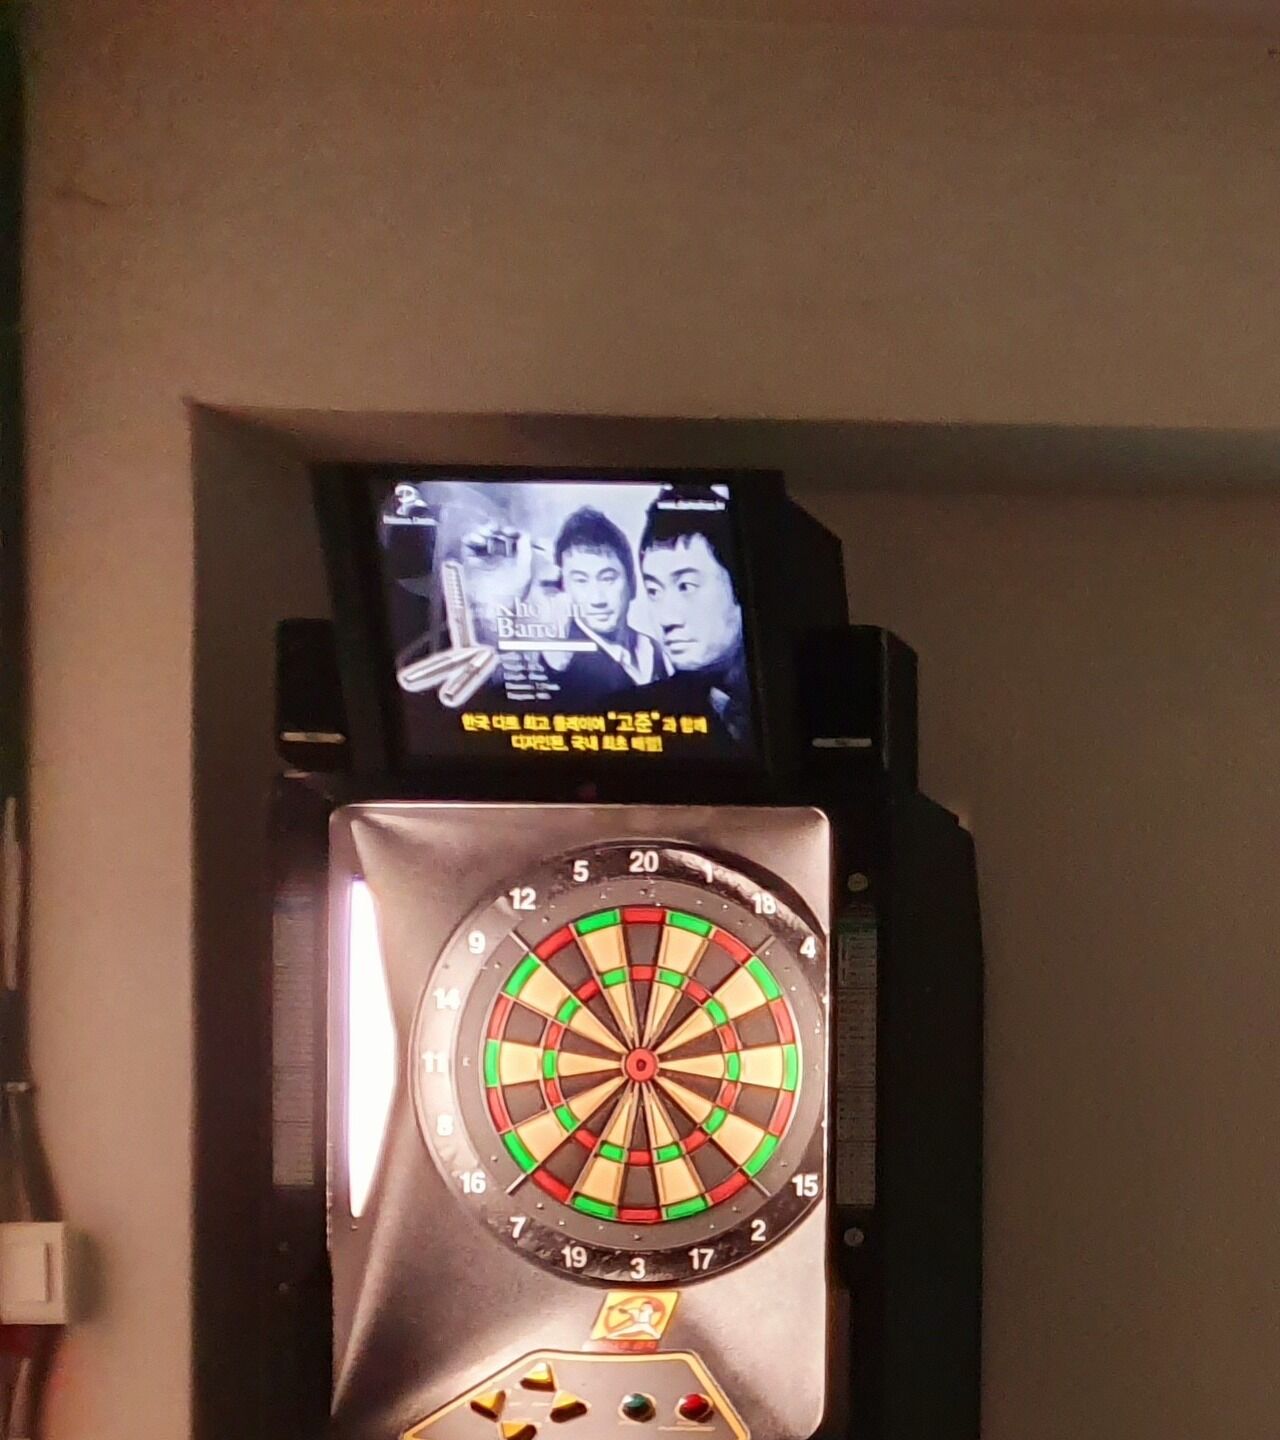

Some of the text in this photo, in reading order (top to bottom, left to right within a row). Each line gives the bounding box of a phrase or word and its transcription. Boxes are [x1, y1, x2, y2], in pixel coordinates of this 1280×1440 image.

[498, 617, 567, 639] Barrel
[572, 860, 590, 883] 5
[629, 851, 659, 873] 20
[704, 864, 714, 883] 1
[509, 887, 536, 911] 12
[753, 892, 777, 916] 18
[468, 930, 486, 954] 9
[800, 936, 816, 958] 4
[422, 1051, 448, 1073] 11
[460, 1171, 486, 1194] 16
[792, 1173, 819, 1197] 15
[509, 1216, 527, 1239] 7
[751, 1219, 767, 1242] 2
[561, 1247, 588, 1269] 19
[630, 1257, 646, 1279] 3
[689, 1247, 716, 1270] 17
